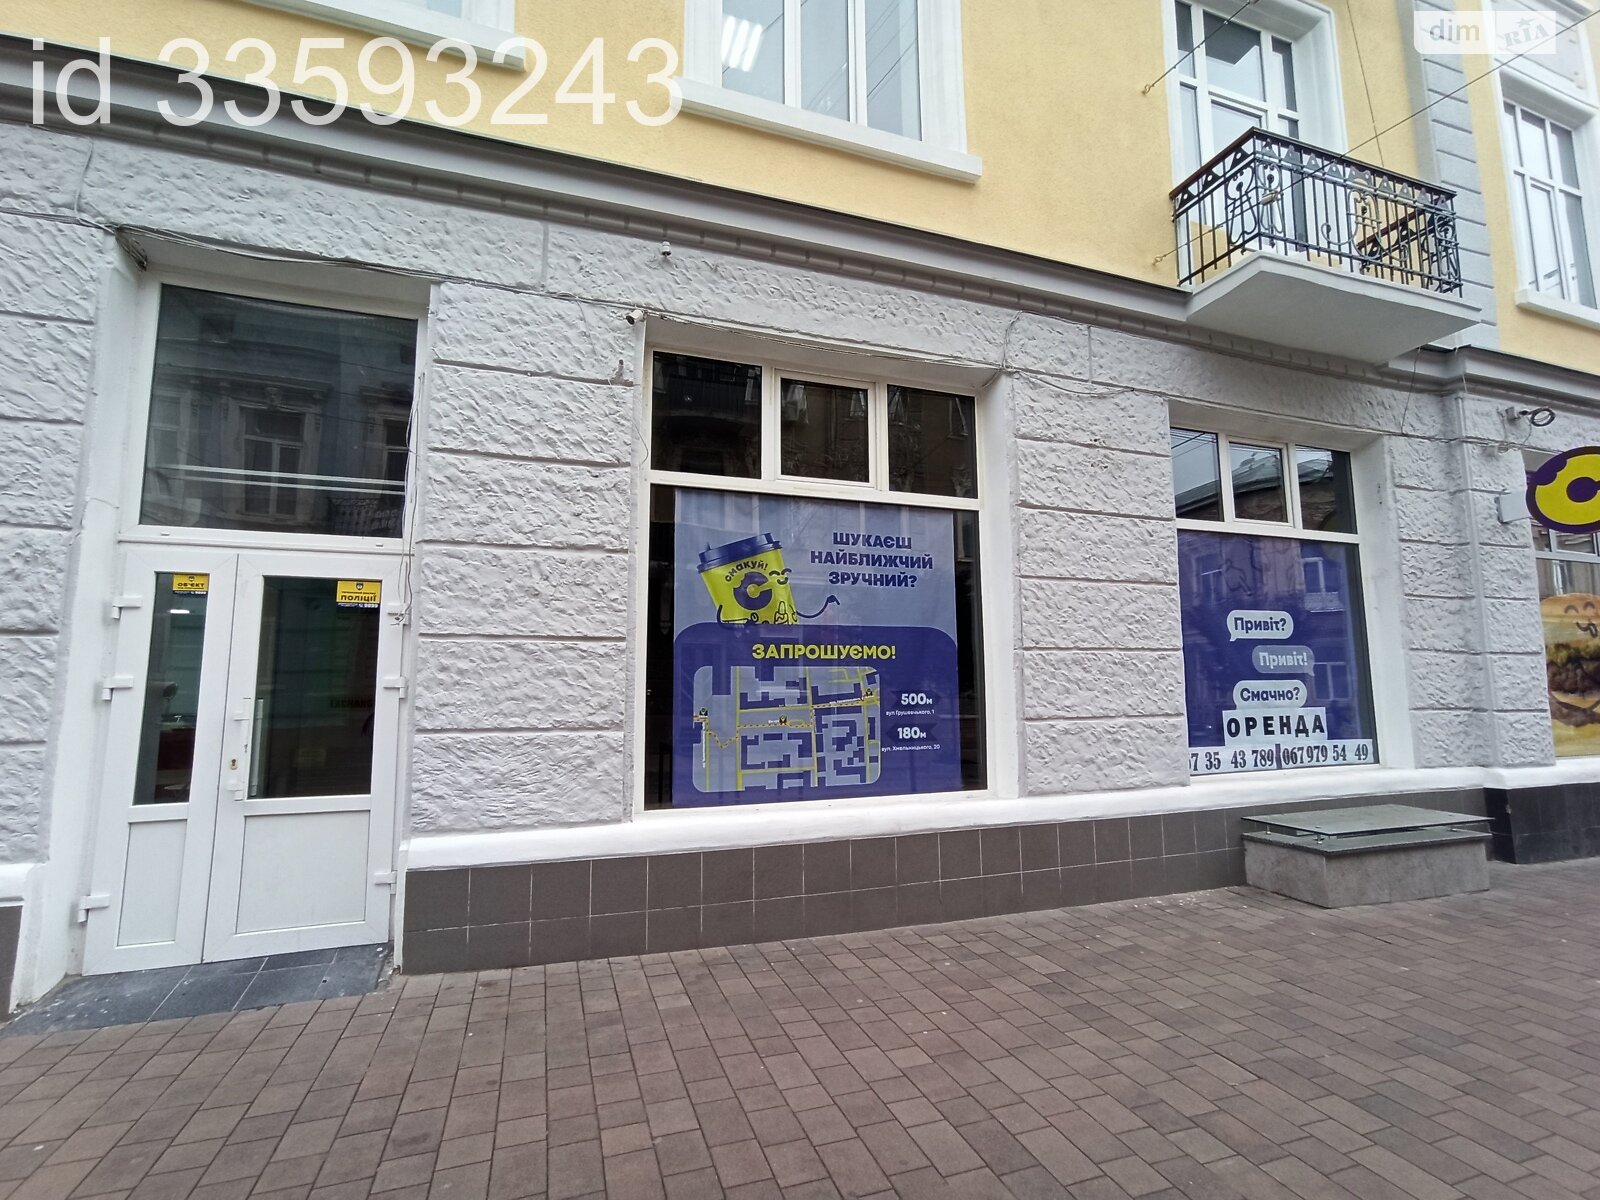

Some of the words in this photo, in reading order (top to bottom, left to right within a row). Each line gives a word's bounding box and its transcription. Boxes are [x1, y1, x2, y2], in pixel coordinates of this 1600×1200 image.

[832, 532, 912, 549] ШУКАЄШ
[810, 548, 933, 569] НАЙБЛИЖЧИЙ
[828, 571, 918, 588] ЗРУЧНИЙ?
[340, 594, 377, 602] ПОЛІЦІЇ
[1233, 616, 1287, 634] Привіт?
[752, 643, 896, 660] ЗАПРОШУЄМО!
[1259, 651, 1308, 669] Привіт!
[1239, 686, 1301, 702] Смачно?
[1226, 714, 1325, 738] ОРЕНДА
[1204, 752, 1221, 770] 35
[1230, 751, 1247, 769] 43
[1251, 748, 1274, 768] 789
[1332, 744, 1347, 762] 54
[1354, 743, 1369, 761] 49
